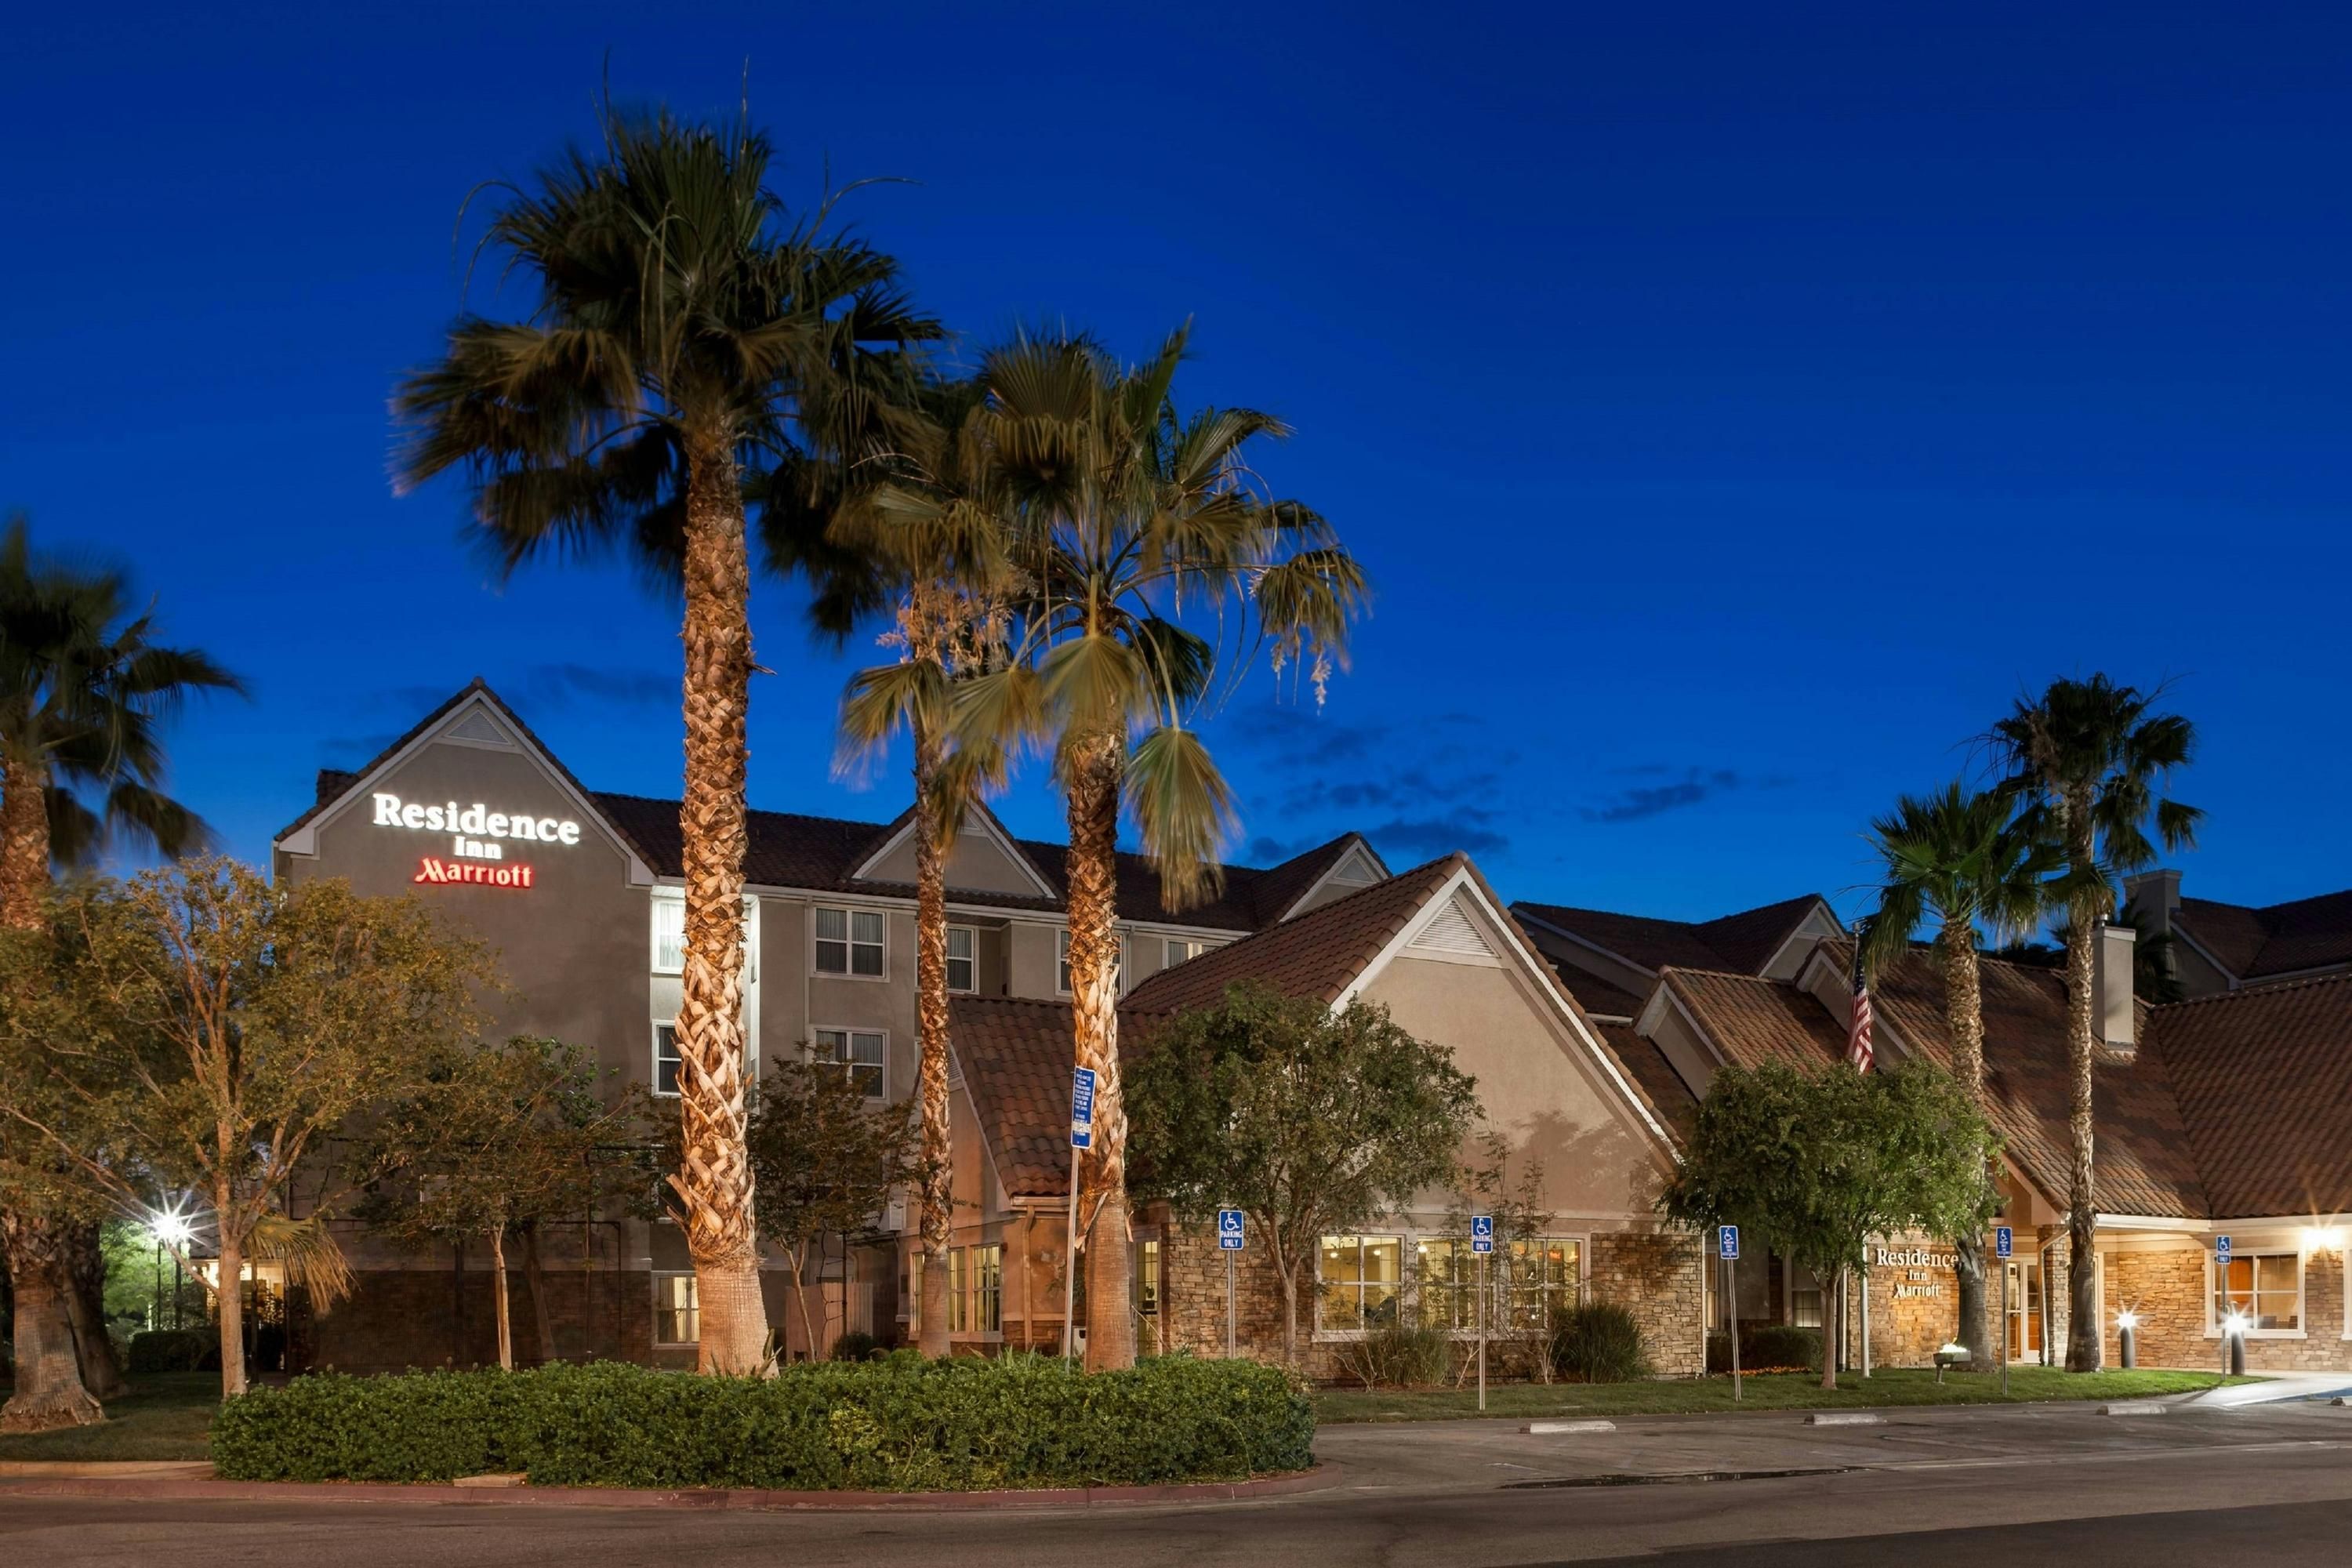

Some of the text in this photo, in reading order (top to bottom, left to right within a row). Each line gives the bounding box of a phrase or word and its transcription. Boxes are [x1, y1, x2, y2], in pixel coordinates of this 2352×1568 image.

[372, 793, 580, 844] Residence
[454, 836, 503, 859] Inn
[414, 858, 532, 887] Marriott
[1224, 1239, 1239, 1247] ONLY
[1876, 1248, 1959, 1268] Residence
[1908, 1269, 1928, 1281] Inn
[1893, 1283, 1940, 1299] Marriott
